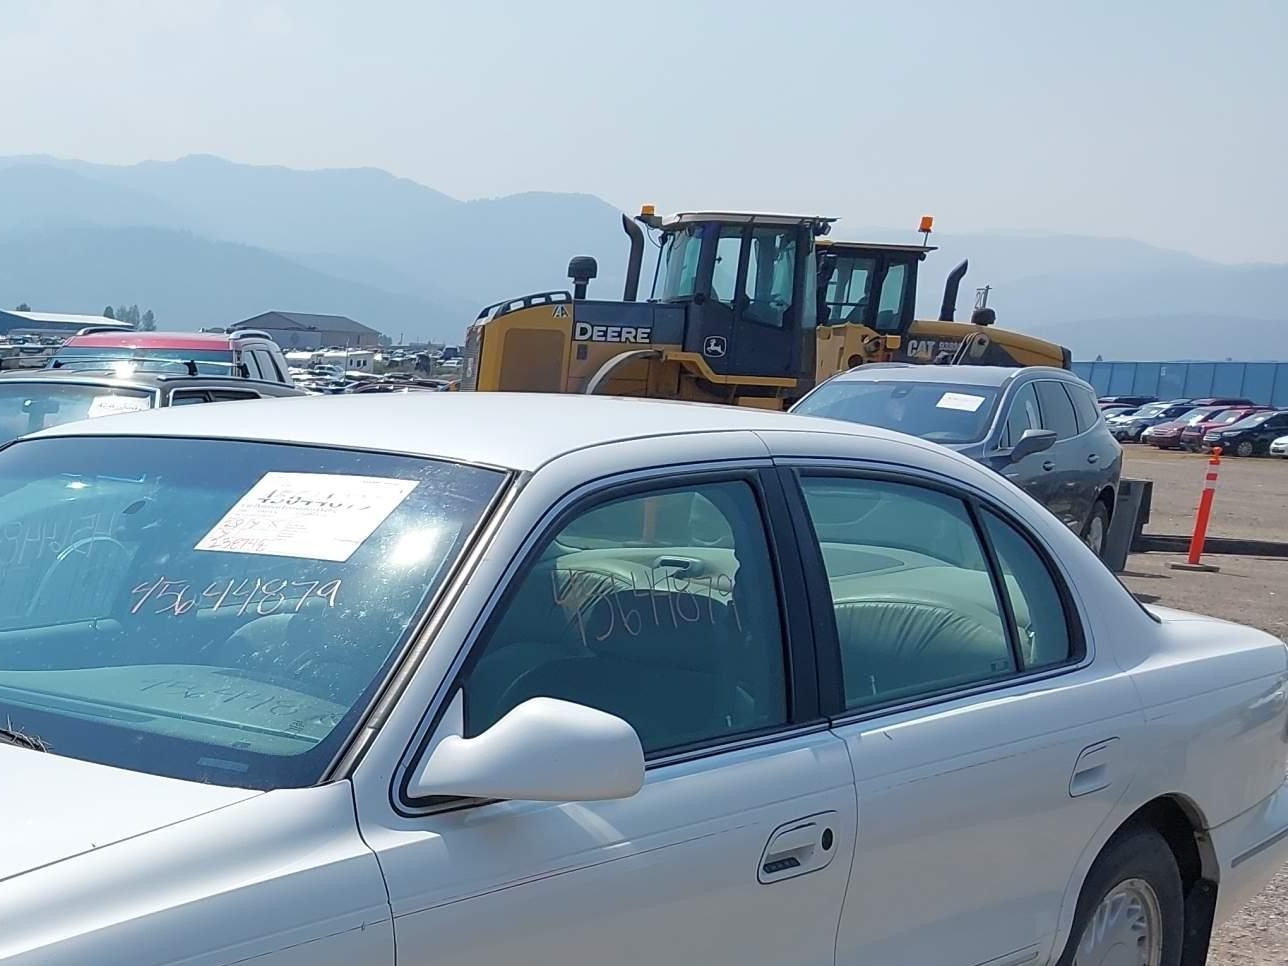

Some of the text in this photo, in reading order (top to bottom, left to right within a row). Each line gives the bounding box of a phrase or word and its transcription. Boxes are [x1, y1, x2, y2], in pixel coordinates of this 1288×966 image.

[574, 322, 651, 343] DEERE
[907, 340, 936, 359] CAT
[131, 576, 342, 616] 45644879
